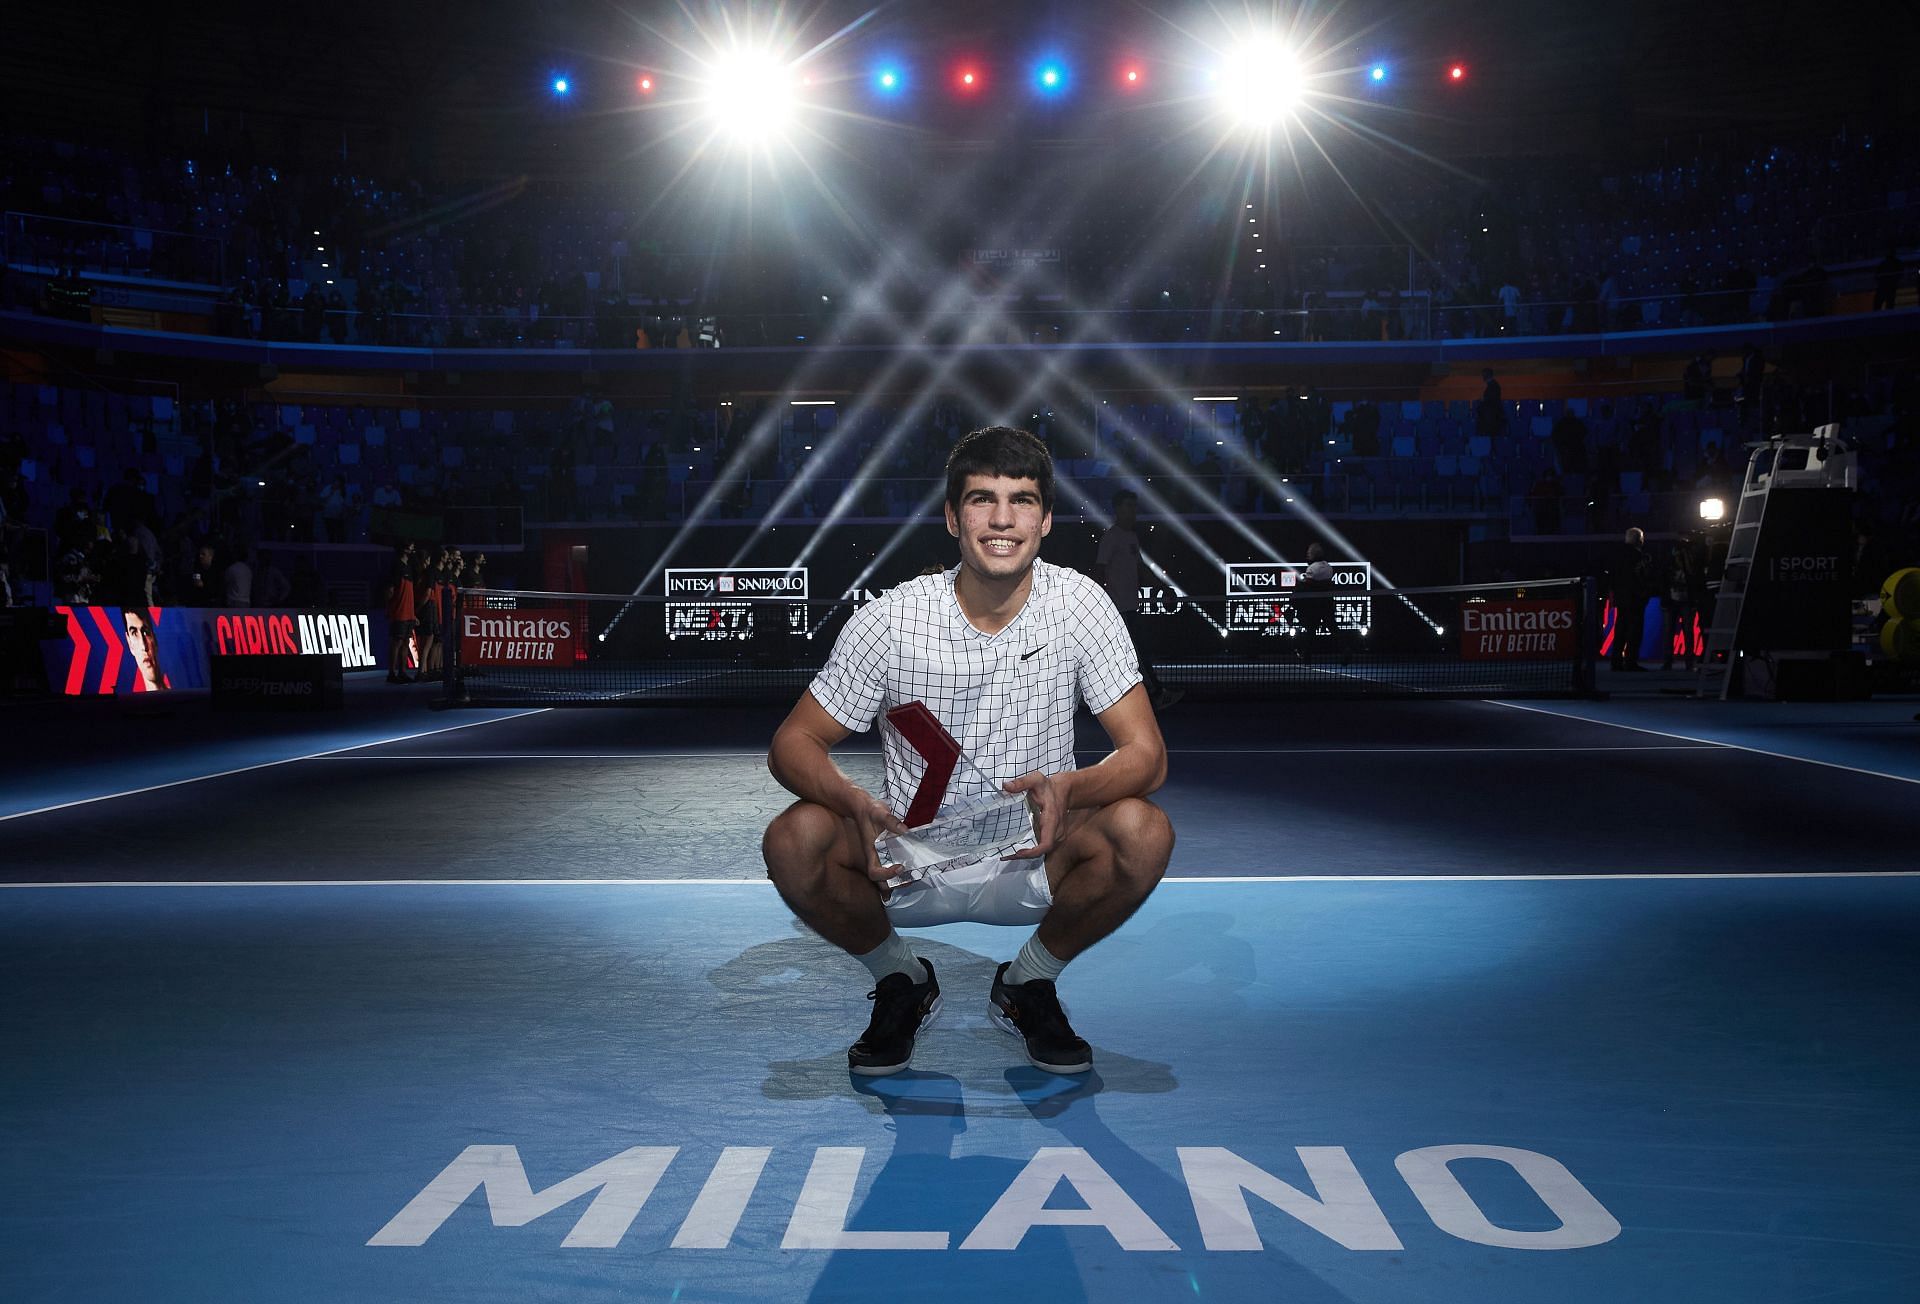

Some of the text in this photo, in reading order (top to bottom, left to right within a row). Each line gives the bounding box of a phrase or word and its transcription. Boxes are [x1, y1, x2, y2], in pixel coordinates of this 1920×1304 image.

[1780, 557, 1838, 570] SPORT
[671, 577, 803, 591] INTESA SANPAOLO
[1231, 573, 1276, 586] INTESA
[1792, 572, 1838, 582] SALUTE
[464, 615, 571, 639] Emirates
[674, 609, 746, 628] NEXT
[1463, 608, 1572, 631] Emirates
[217, 614, 376, 668] CARLOS ALCARAZ
[480, 641, 554, 660] FLY BETTER
[1480, 632, 1557, 653] FLY BETTER
[364, 1143, 1622, 1251] MILANO
